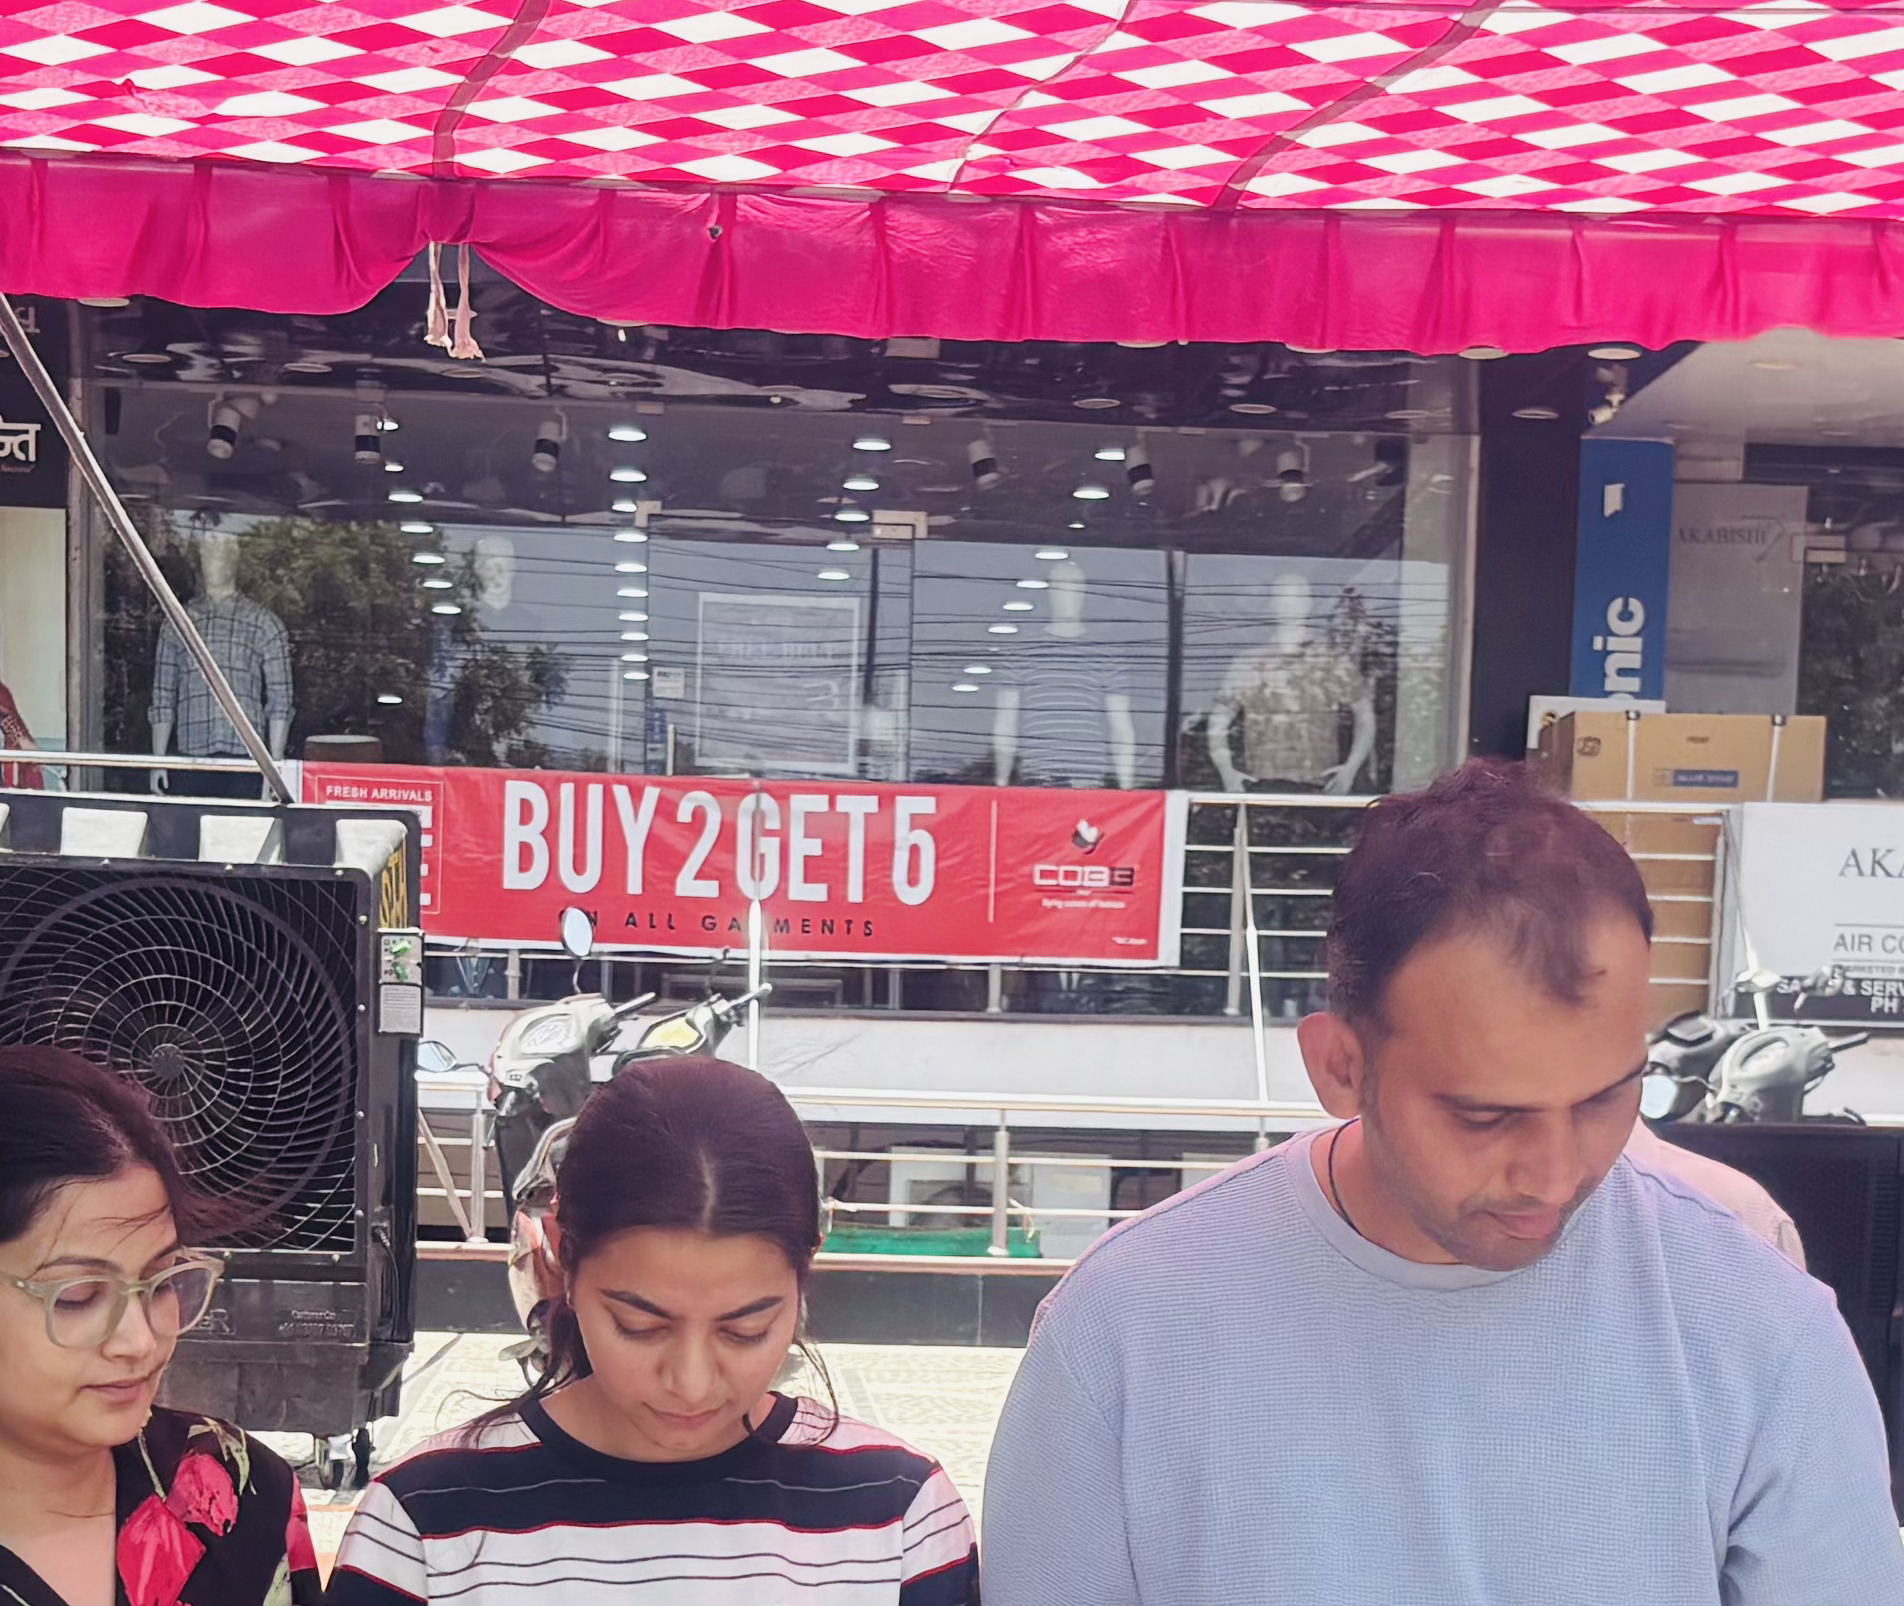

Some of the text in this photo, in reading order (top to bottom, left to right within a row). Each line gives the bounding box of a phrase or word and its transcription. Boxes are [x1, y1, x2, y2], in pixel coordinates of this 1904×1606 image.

[1593, 596, 1647, 701] nic
[325, 785, 433, 802] FRESH ARRIVALS
[502, 779, 662, 895] BUY
[674, 790, 723, 899] 2
[735, 792, 879, 904] GET
[892, 795, 937, 906] 5
[624, 911, 677, 931] ALL
[700, 914, 874, 938] GAMENTS
[1833, 933, 1872, 952] AIR
[1871, 996, 1898, 1014] PH
